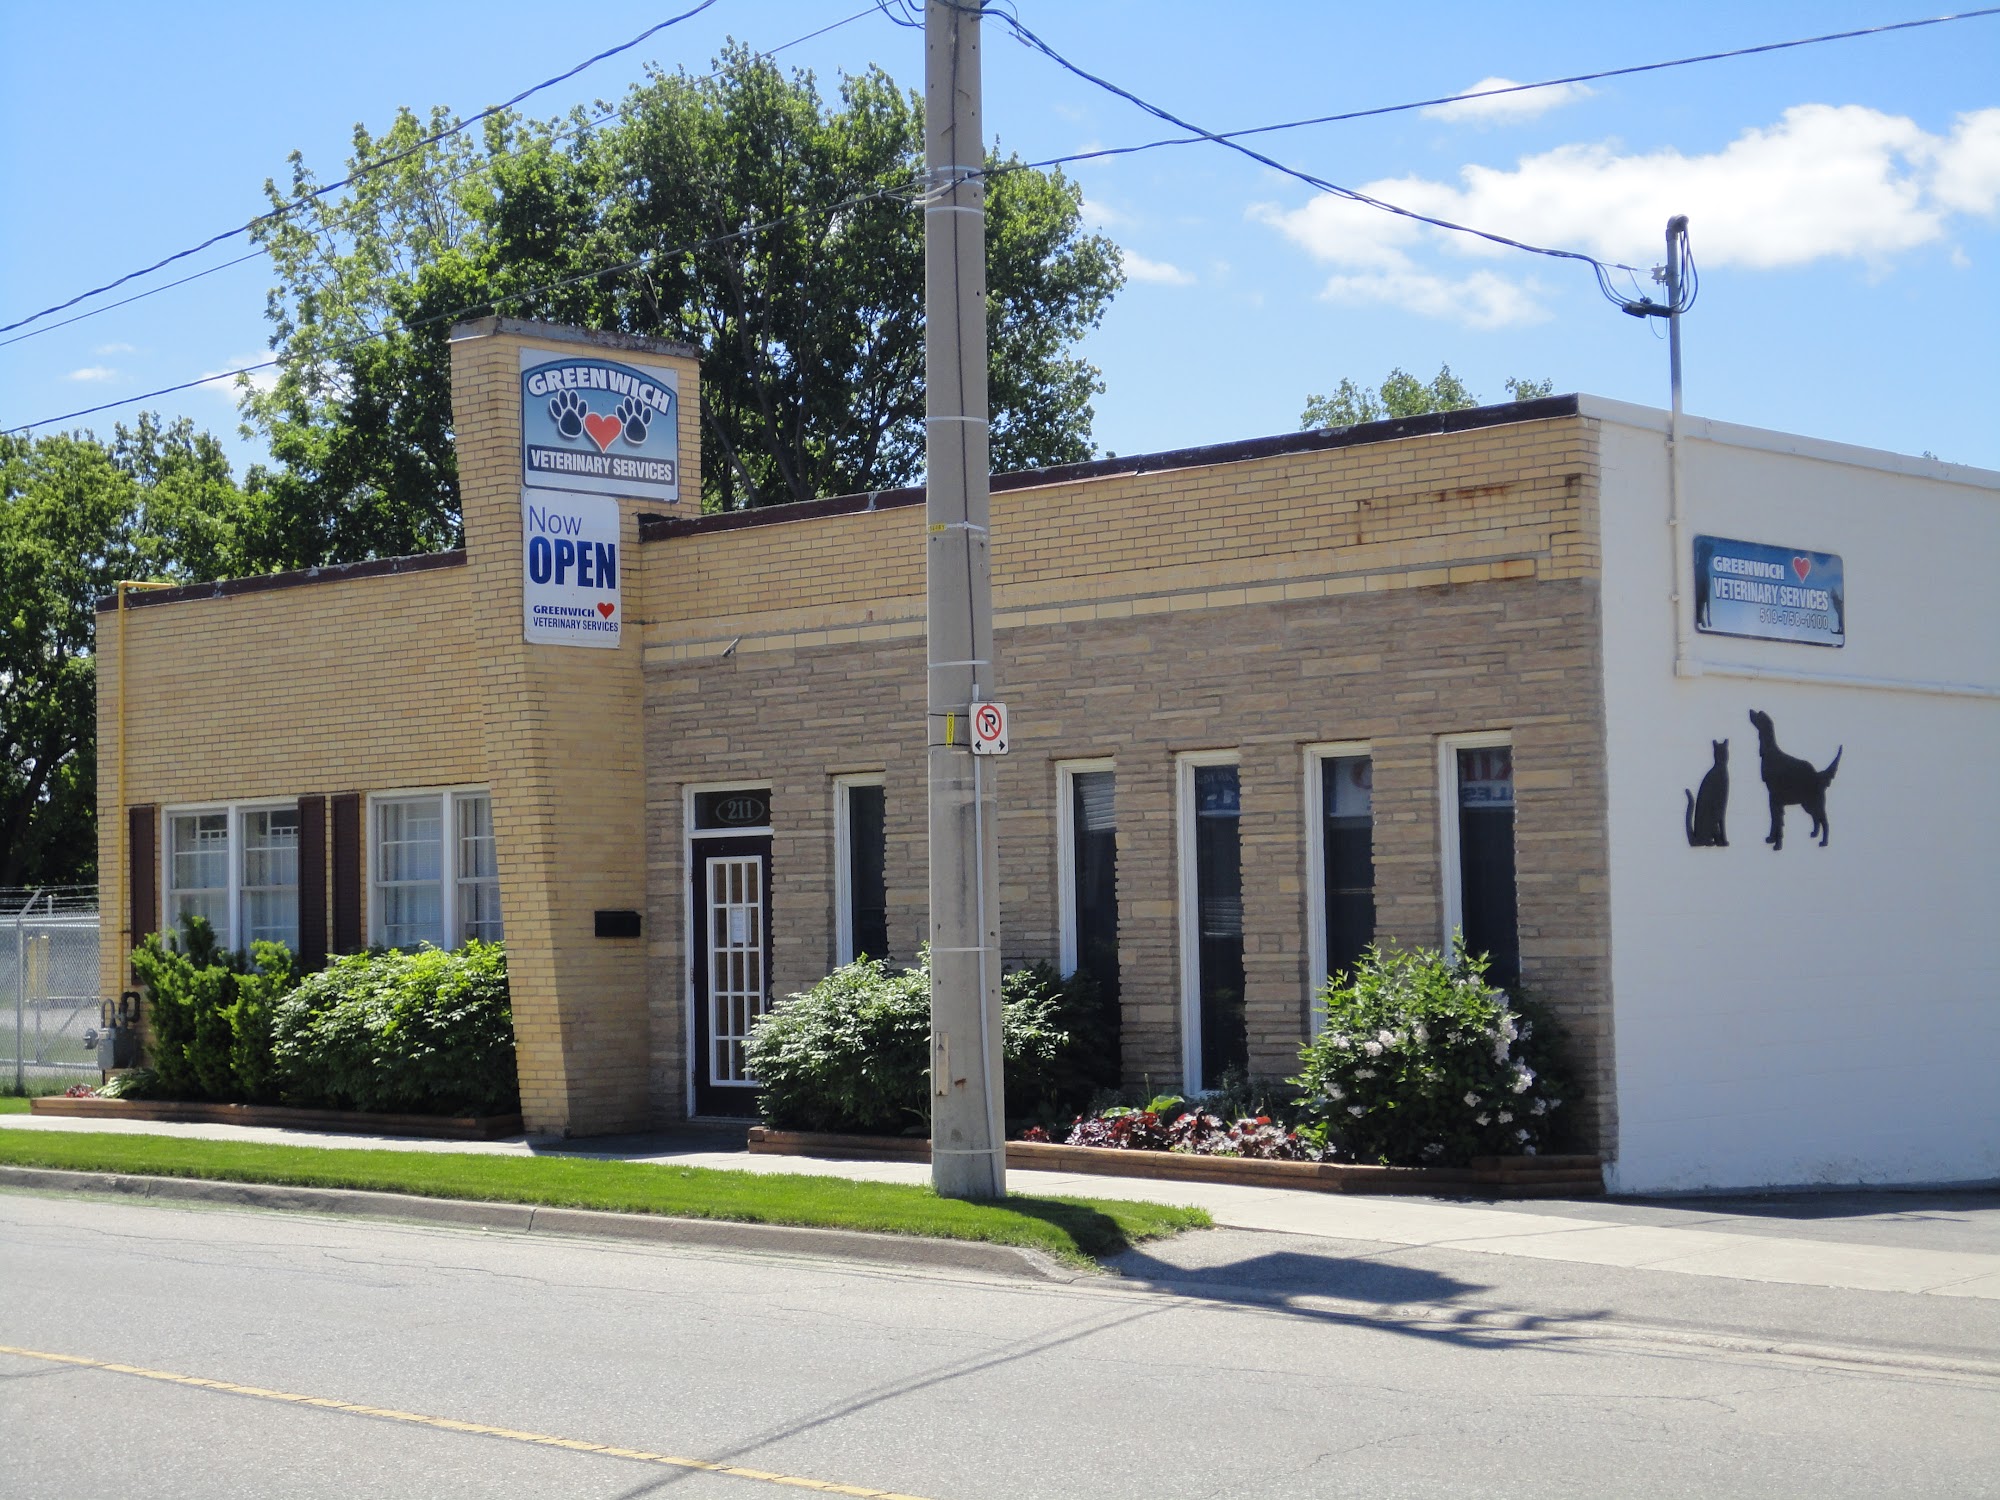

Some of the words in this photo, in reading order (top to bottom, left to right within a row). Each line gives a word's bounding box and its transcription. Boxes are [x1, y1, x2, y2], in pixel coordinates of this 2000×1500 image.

[527, 367, 671, 414] GREENWICH
[531, 449, 611, 475] VETERINARY
[613, 458, 672, 481] SERVICES
[529, 536, 616, 589] OPEN
[1713, 556, 1785, 580] GREENWICH
[1713, 577, 1779, 605] VETERINARY
[1780, 585, 1829, 611] SERVICES
[533, 605, 595, 617] GREENWICH
[533, 617, 581, 629] VETERINARY
[582, 620, 619, 632] SERVICES
[984, 714, 996, 732] P
[727, 800, 753, 819] 211
